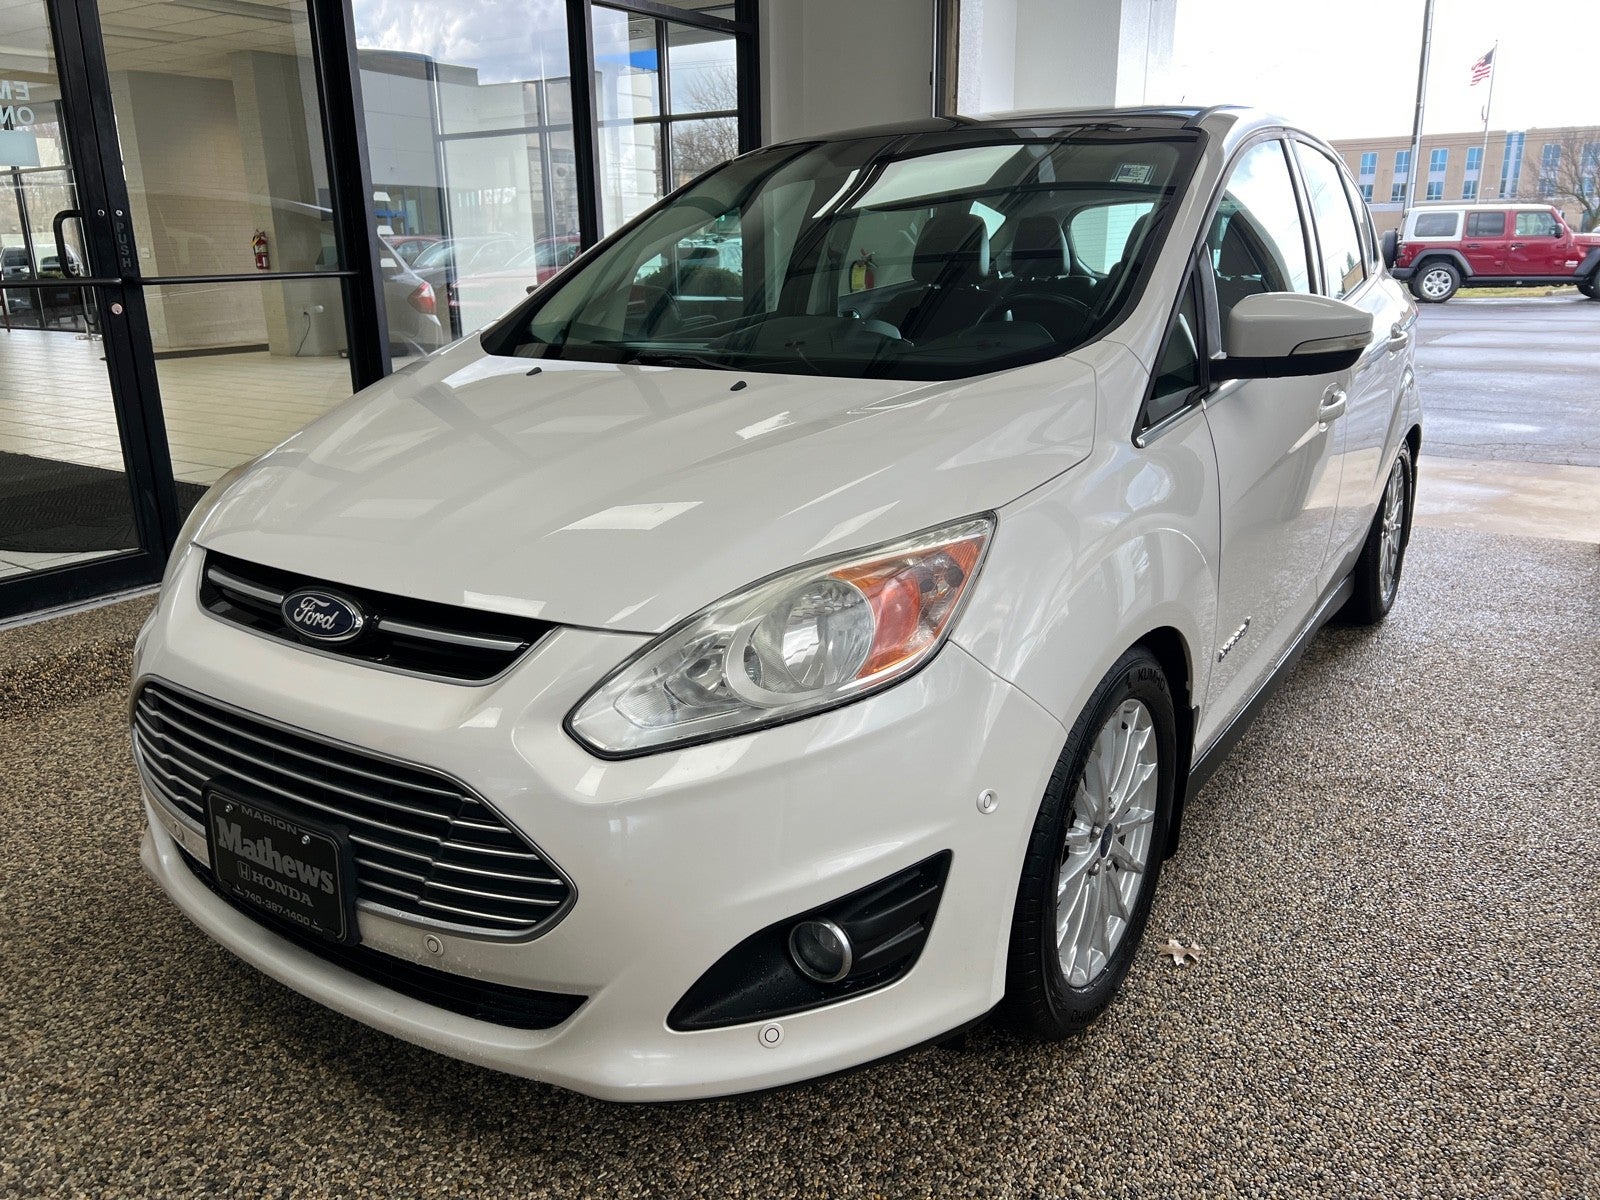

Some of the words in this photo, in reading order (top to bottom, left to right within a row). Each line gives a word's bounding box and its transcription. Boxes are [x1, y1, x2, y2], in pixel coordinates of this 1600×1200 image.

[116, 222, 131, 268] PUSH
[294, 597, 339, 630] Ford
[1137, 667, 1166, 691] KUMHO
[241, 804, 298, 835] MARION
[216, 815, 334, 895] Mathews
[252, 870, 314, 907] HONDA
[244, 889, 310, 926] 740-387-1400
